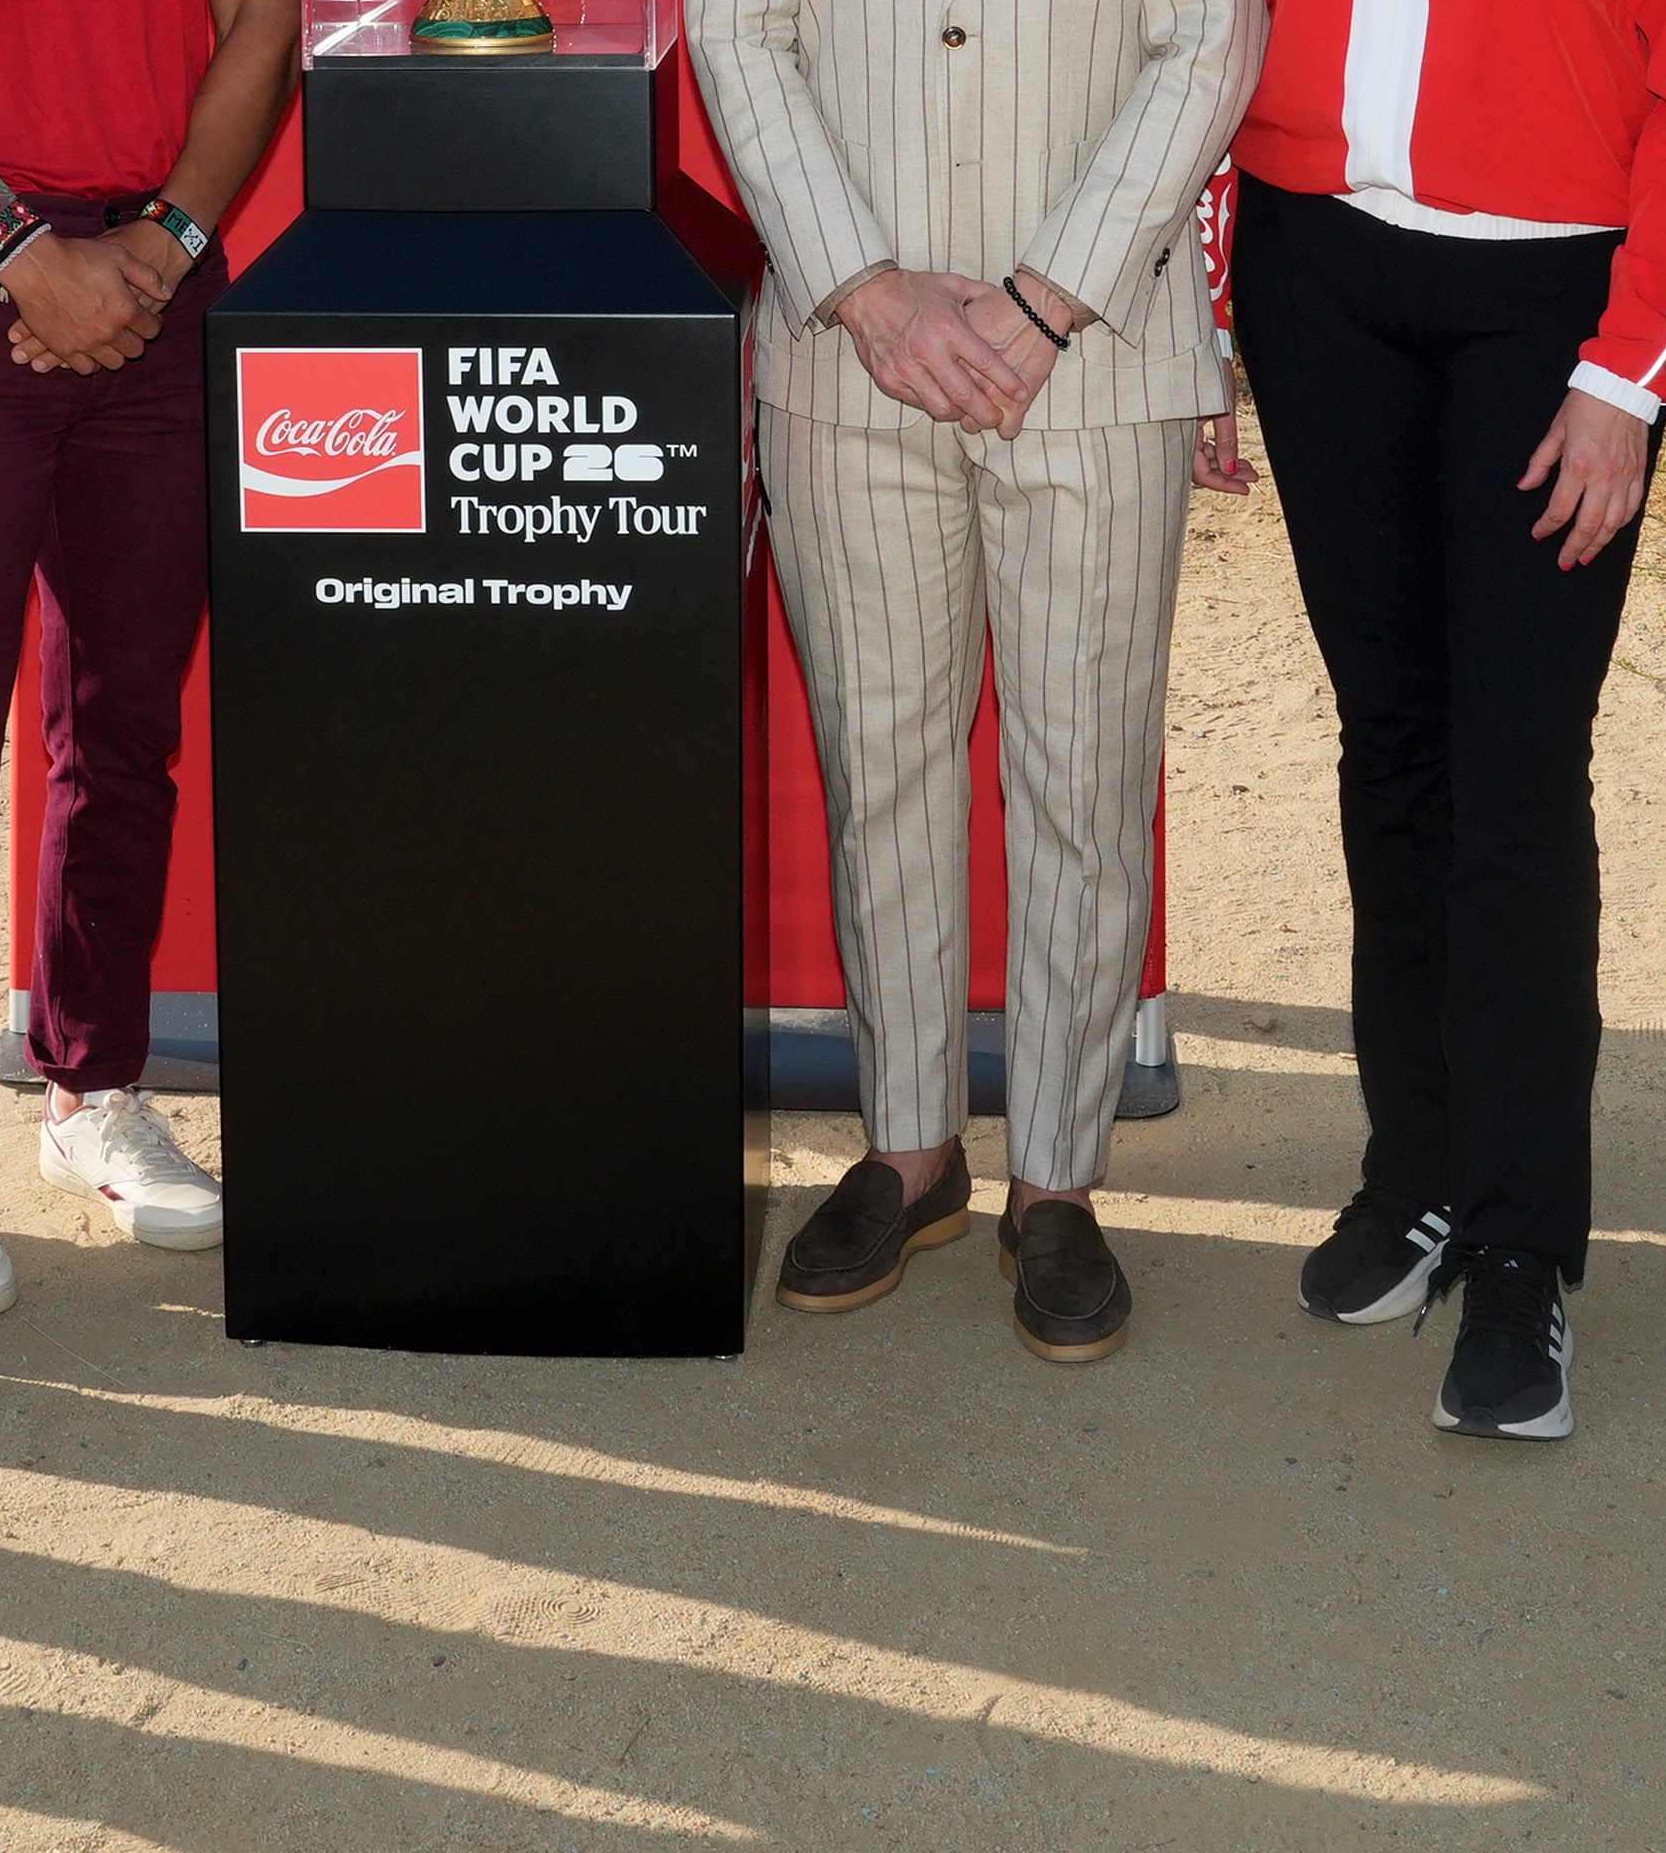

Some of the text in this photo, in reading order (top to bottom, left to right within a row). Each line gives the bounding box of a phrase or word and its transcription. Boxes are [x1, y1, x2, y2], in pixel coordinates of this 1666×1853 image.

[448, 347, 559, 386] FIFA
[255, 408, 407, 459] Coca-Cola
[447, 394, 638, 434] WORLD
[449, 442, 552, 482] CUP
[450, 495, 707, 544] Trophy Tour
[315, 577, 633, 611] Original Trophy
